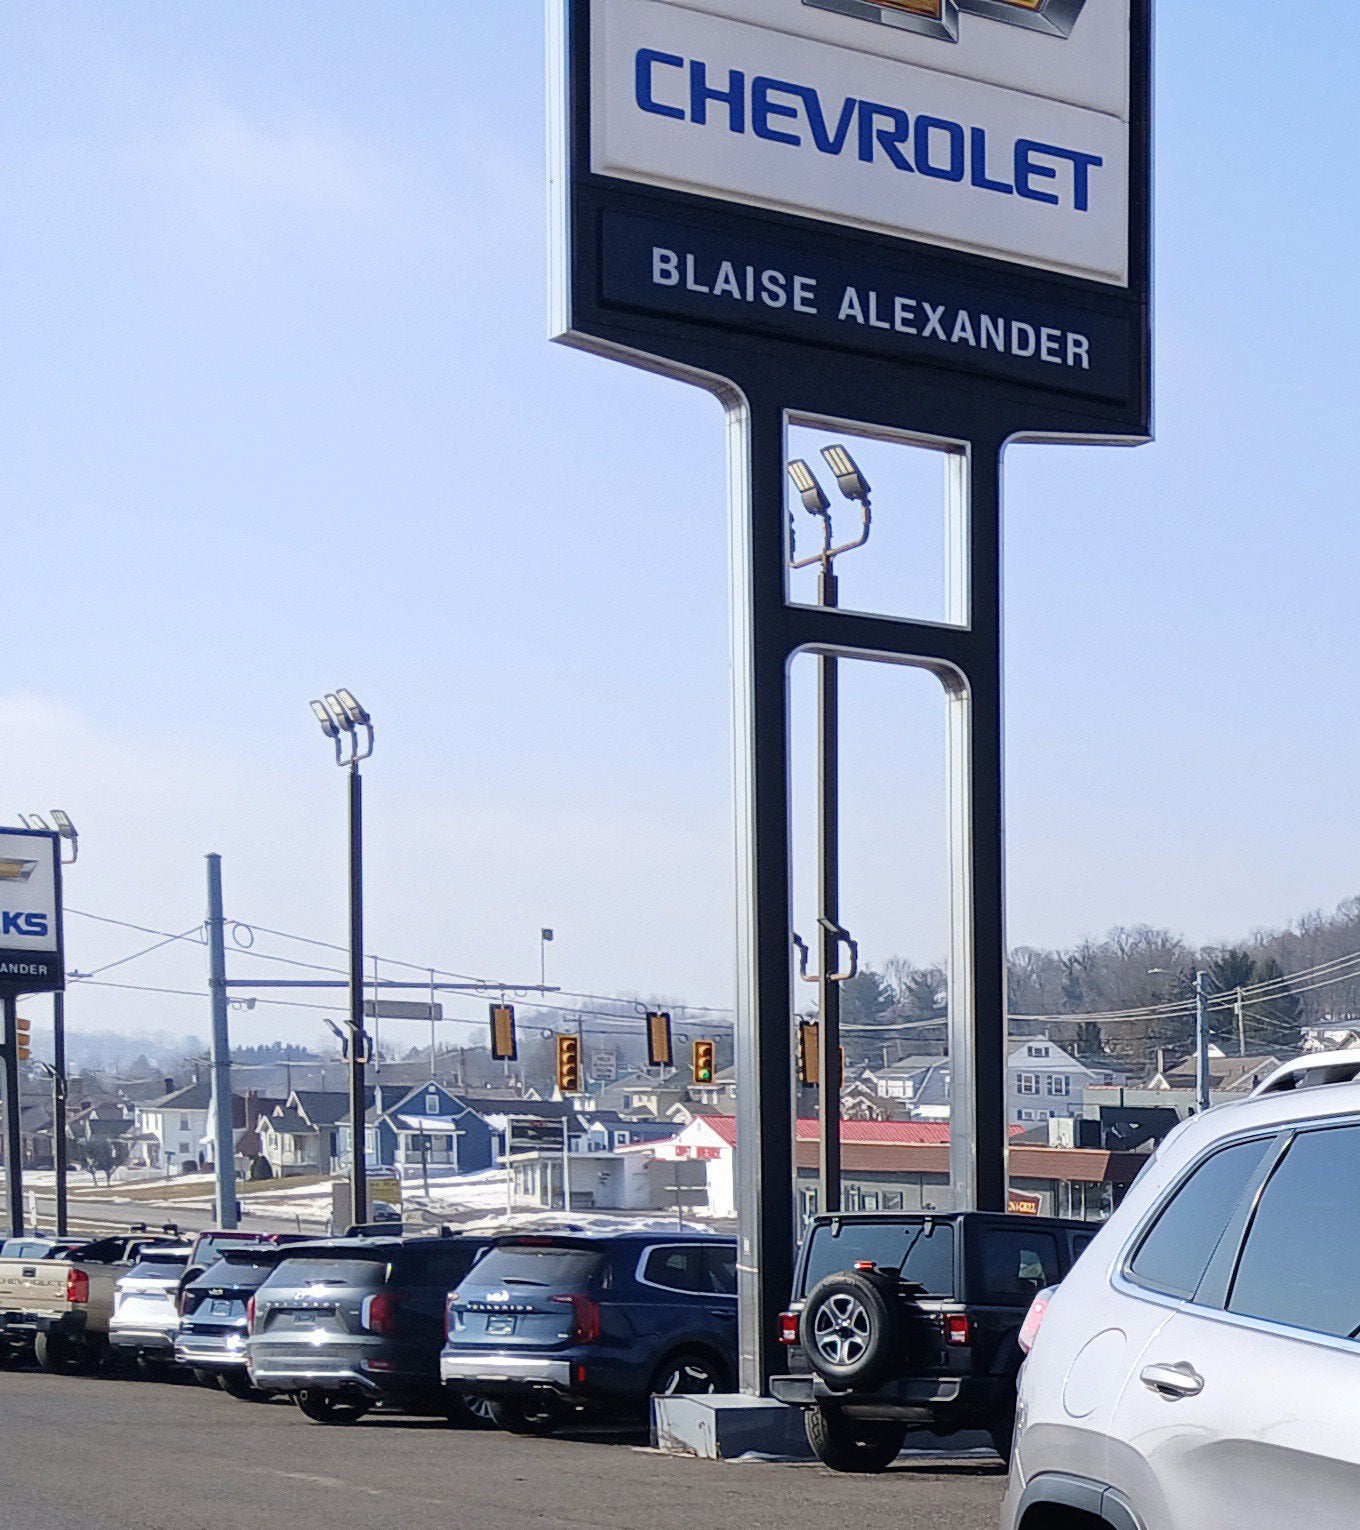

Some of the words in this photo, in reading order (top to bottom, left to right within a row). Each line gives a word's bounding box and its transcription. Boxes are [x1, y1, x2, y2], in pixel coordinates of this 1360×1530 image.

[634, 47, 1104, 212] CHEVROLET
[651, 246, 818, 315] BLAISE
[837, 285, 1091, 370] ALEXANDER
